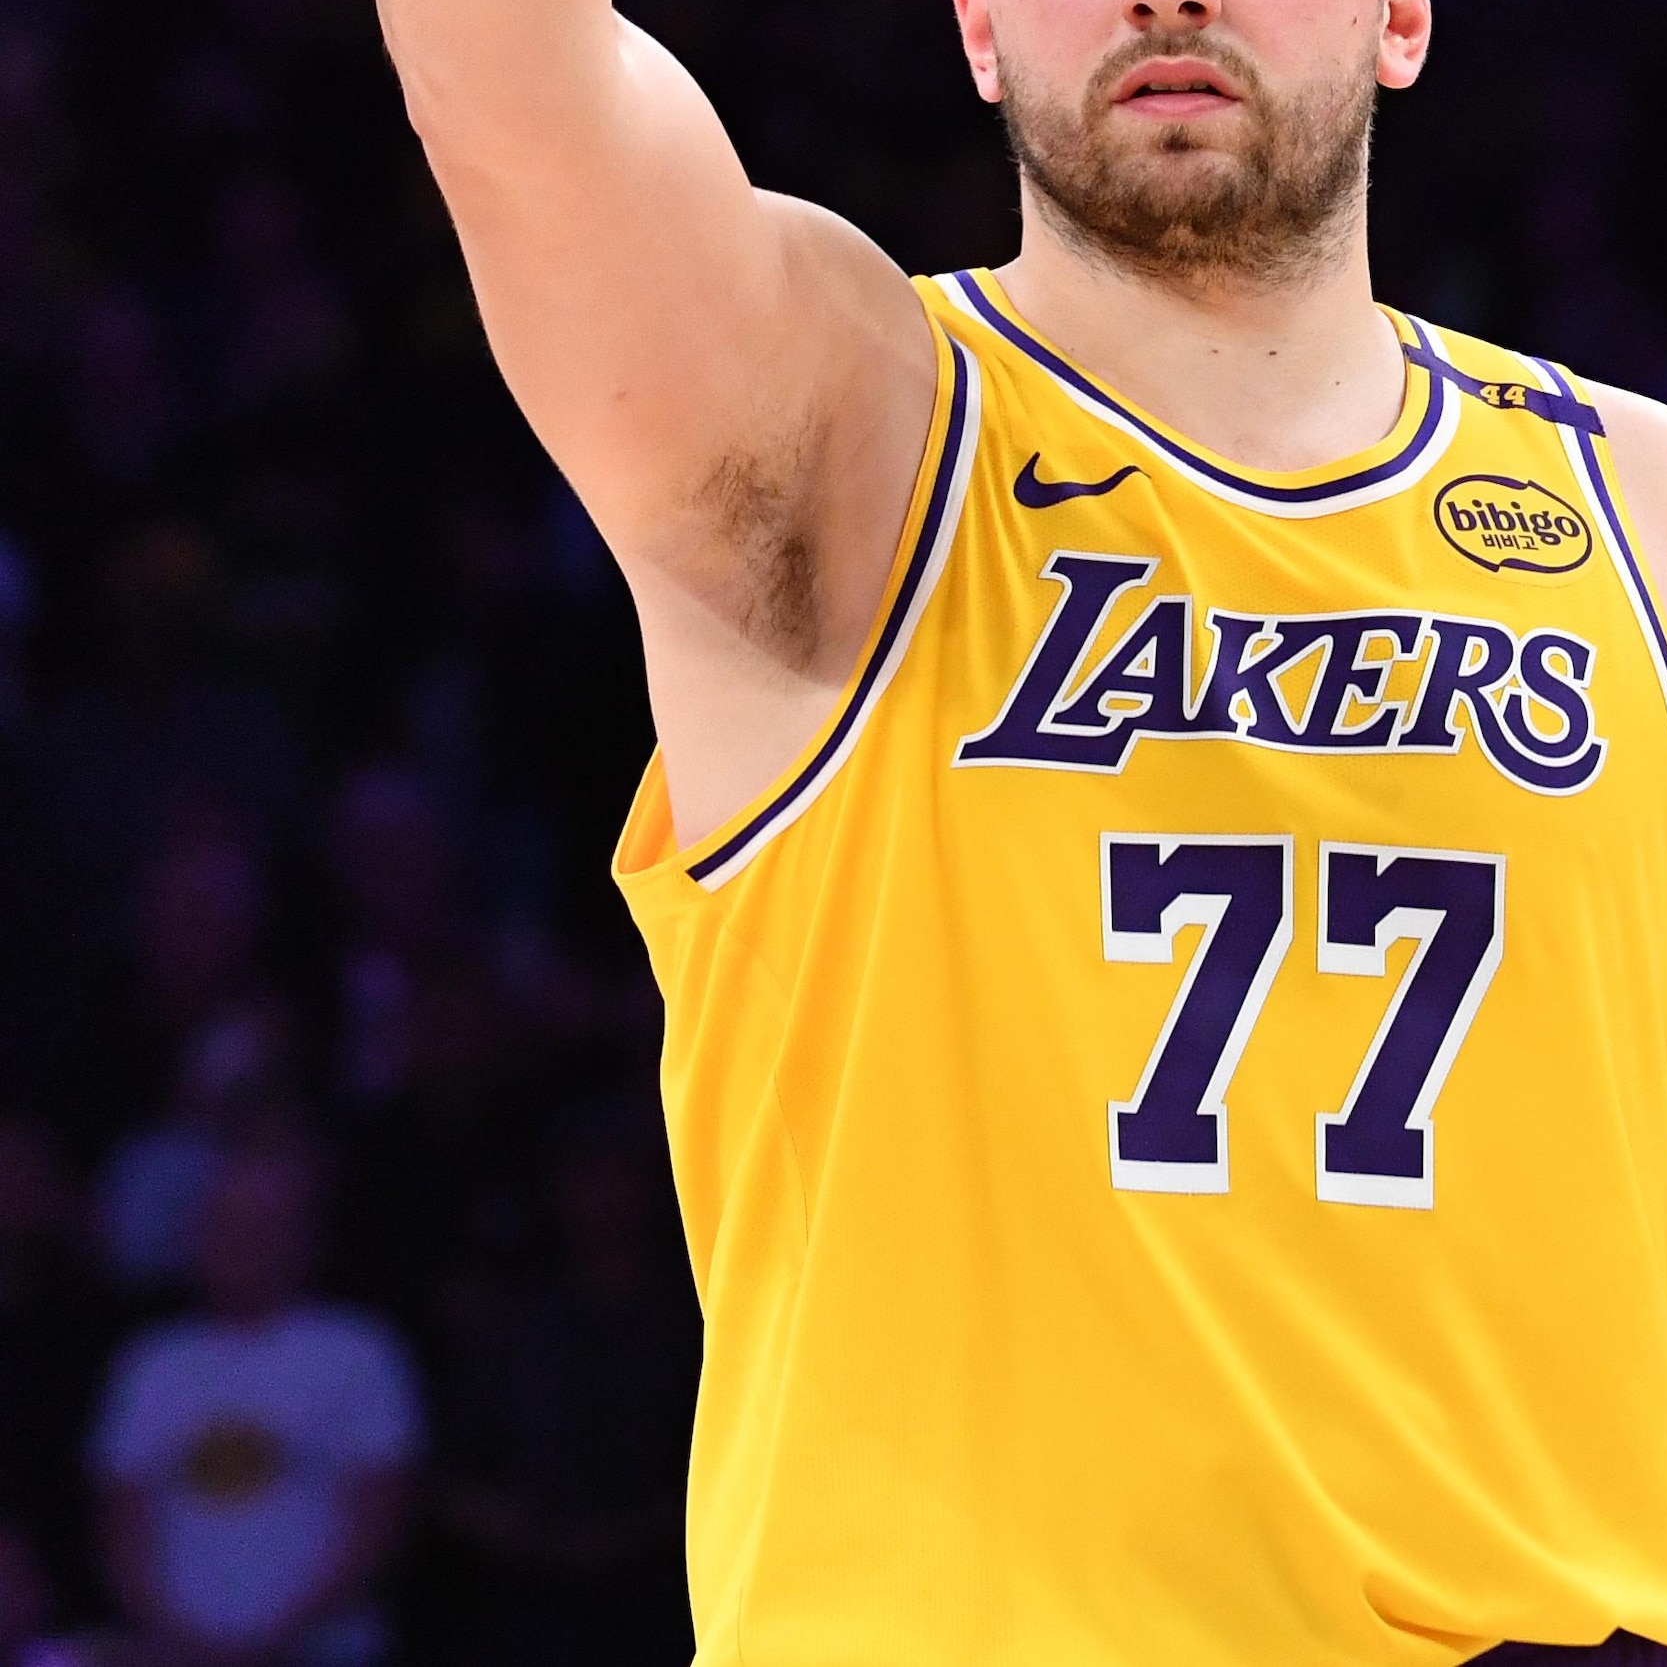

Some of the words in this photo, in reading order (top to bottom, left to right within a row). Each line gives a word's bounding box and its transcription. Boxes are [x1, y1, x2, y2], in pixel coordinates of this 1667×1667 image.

[1480, 385, 1525, 405] 44
[1446, 499, 1581, 545] bibigo
[1481, 534, 1539, 550] 비비고
[952, 551, 1608, 798] LAKERS
[1100, 833, 1508, 1211] 77
